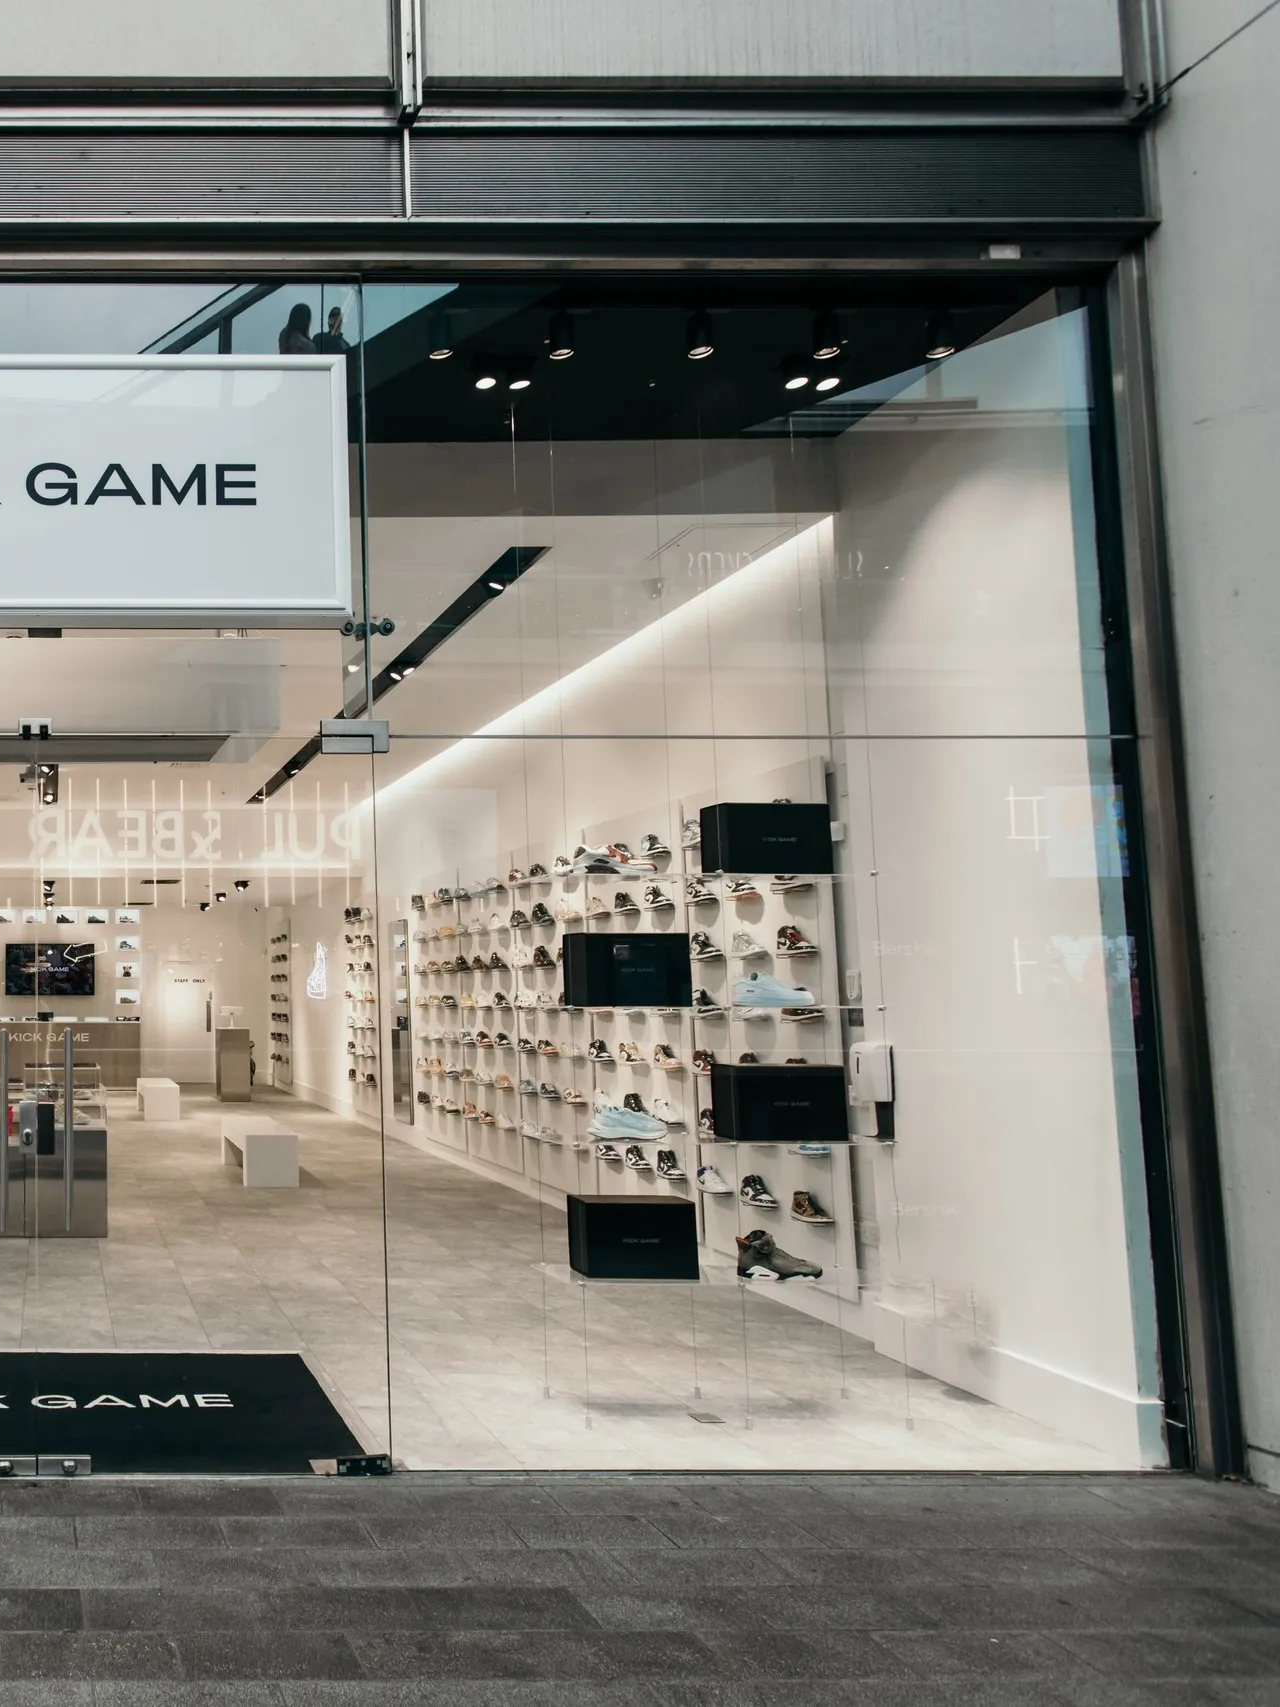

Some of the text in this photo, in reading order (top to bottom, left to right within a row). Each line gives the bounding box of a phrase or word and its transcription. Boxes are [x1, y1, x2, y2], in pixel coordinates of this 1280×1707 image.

[25, 462, 257, 506] GAME
[8, 1032, 42, 1042] KICK
[31, 1394, 234, 1409] GAME
